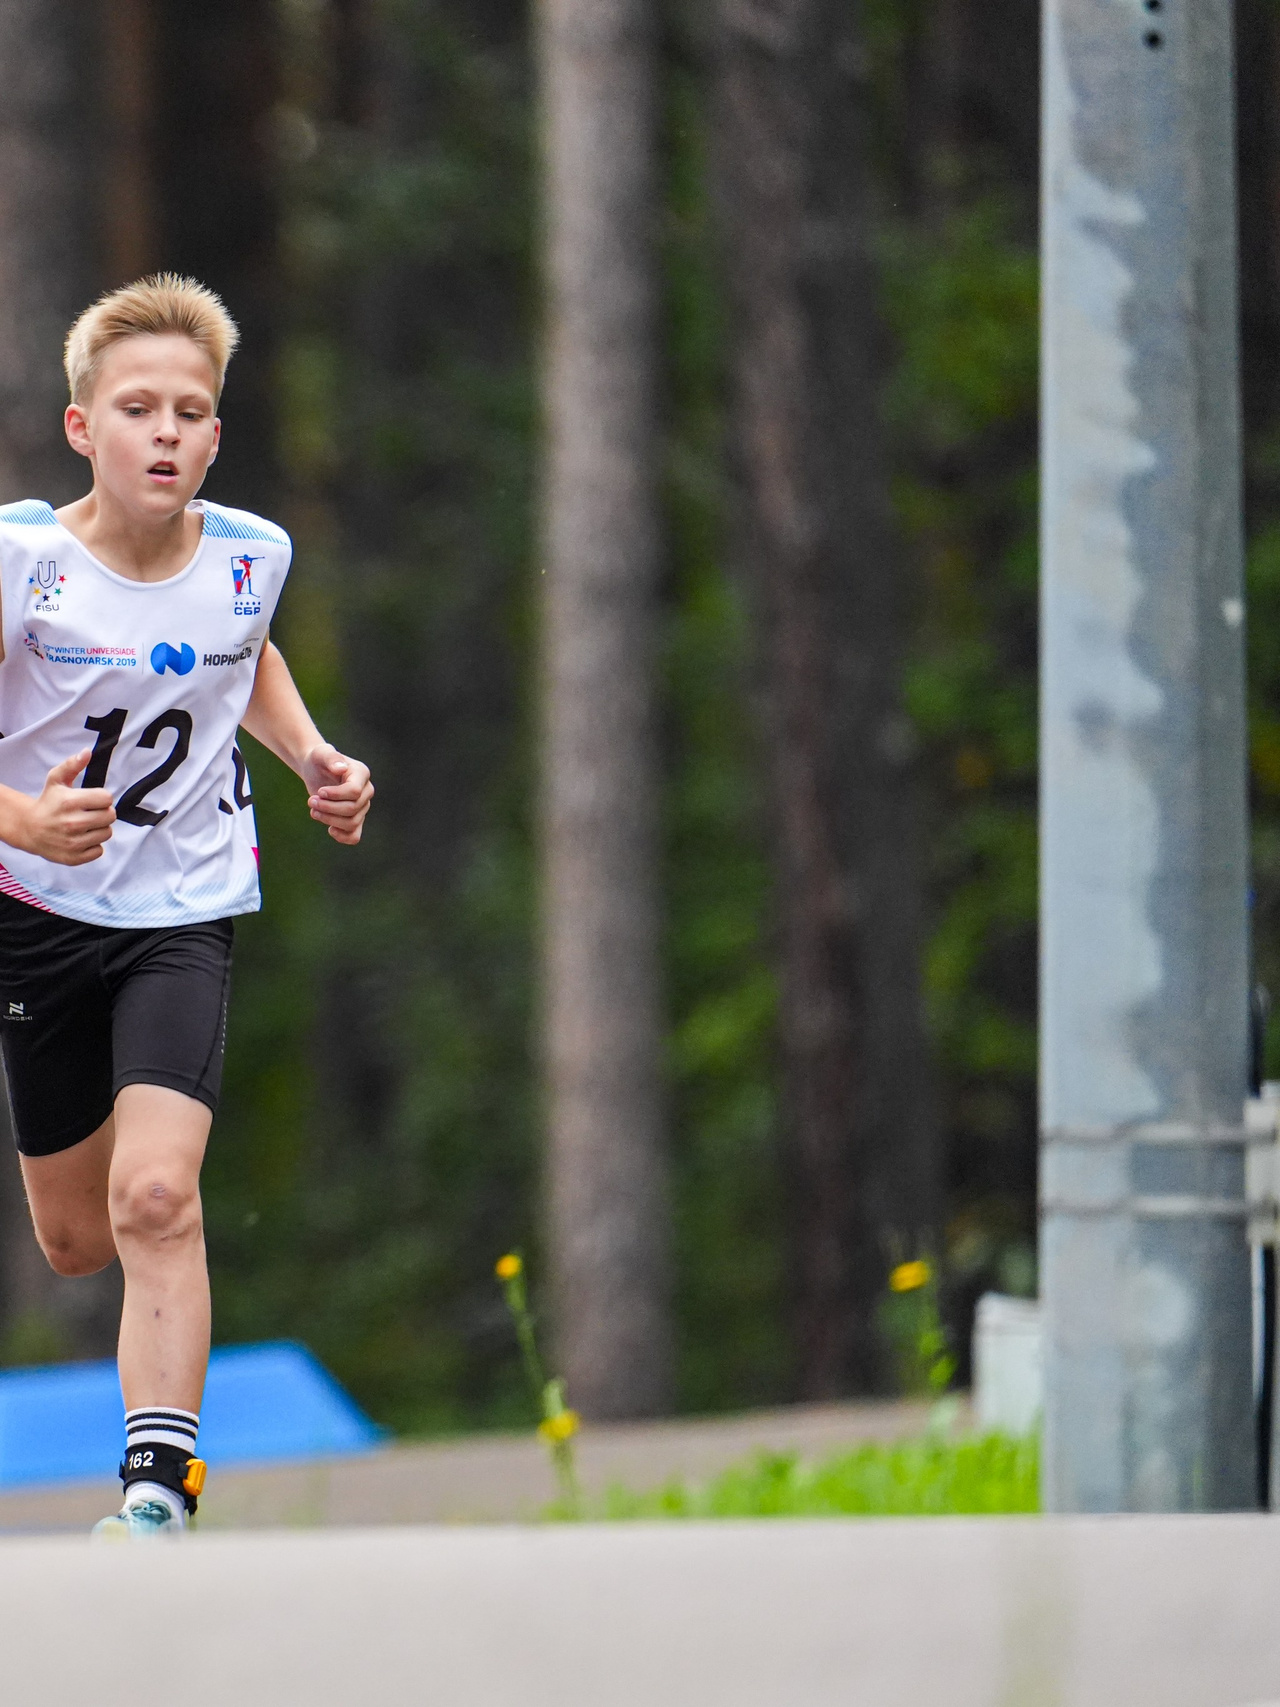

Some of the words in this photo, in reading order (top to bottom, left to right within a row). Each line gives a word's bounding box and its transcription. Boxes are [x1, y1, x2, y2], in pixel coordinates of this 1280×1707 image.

[35, 604, 60, 612] FISU
[234, 607, 261, 615] СБР
[54, 646, 86, 655] WINTER
[86, 647, 137, 656] UNIVERSIADE
[116, 658, 137, 667] 2019
[84, 707, 193, 827] 12
[128, 1450, 154, 1470] 162
